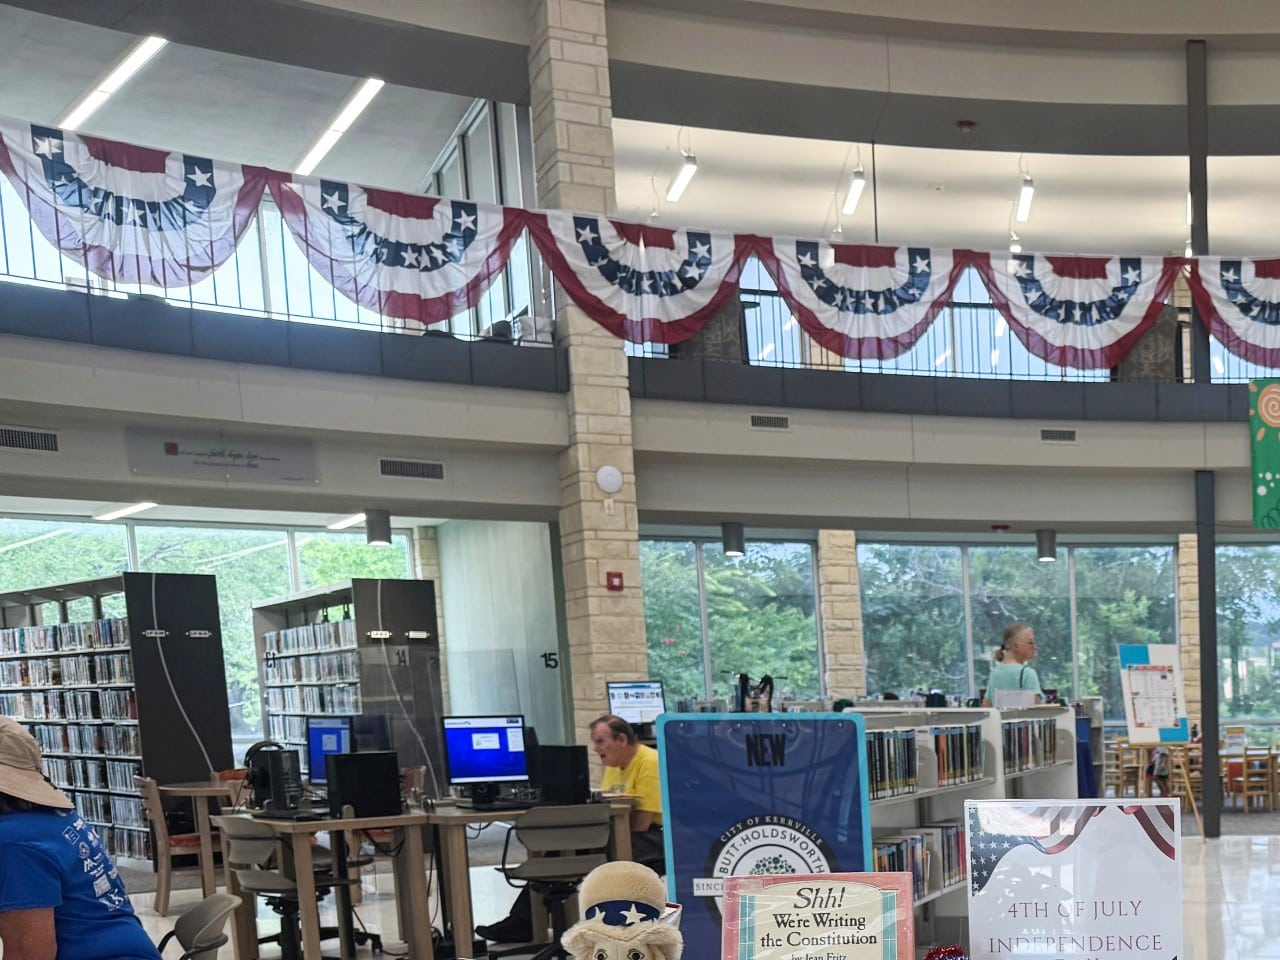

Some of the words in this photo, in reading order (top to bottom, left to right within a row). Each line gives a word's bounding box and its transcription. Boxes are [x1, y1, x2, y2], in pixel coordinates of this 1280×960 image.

[540, 652, 558, 670] 15
[745, 733, 786, 768] NEW
[720, 823, 743, 843] CITY
[747, 816, 761, 826] OF
[765, 815, 823, 846] KERRVILLE
[719, 828, 825, 875] BUTT-HOLDSWORTH
[793, 886, 846, 909] Shh!
[1007, 901, 1049, 918] 4TH
[1057, 901, 1085, 918] OF
[1092, 900, 1143, 920] JULY
[772, 912, 811, 929] We're
[811, 912, 866, 931] Writing
[760, 932, 783, 947] the
[786, 931, 878, 947] Constitution
[989, 934, 1164, 953] INDEPENDENCE
